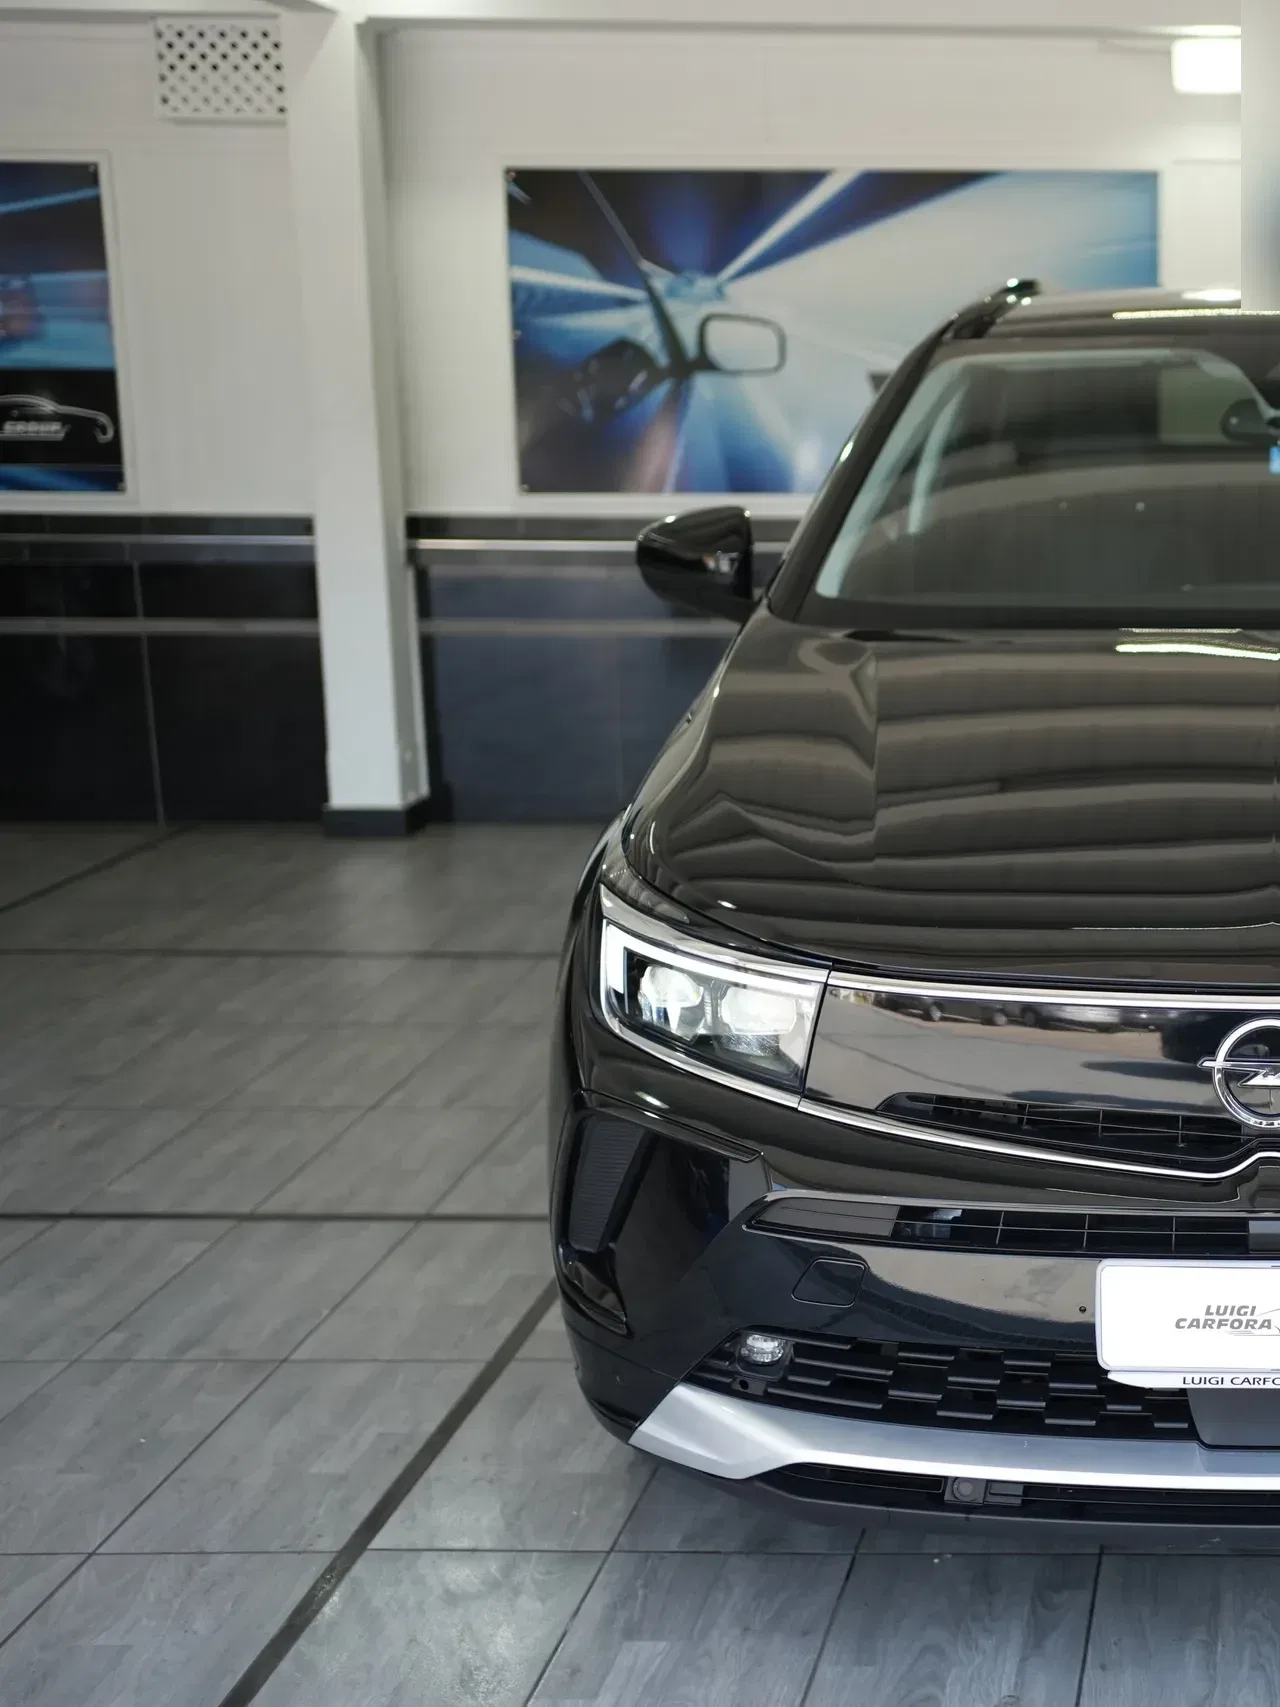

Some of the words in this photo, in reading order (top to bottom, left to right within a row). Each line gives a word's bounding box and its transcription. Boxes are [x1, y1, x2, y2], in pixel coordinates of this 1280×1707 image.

[1205, 1305, 1256, 1316] LUIGI
[1175, 1318, 1272, 1330] CARFORA
[1182, 1376, 1225, 1386] LUIGI
